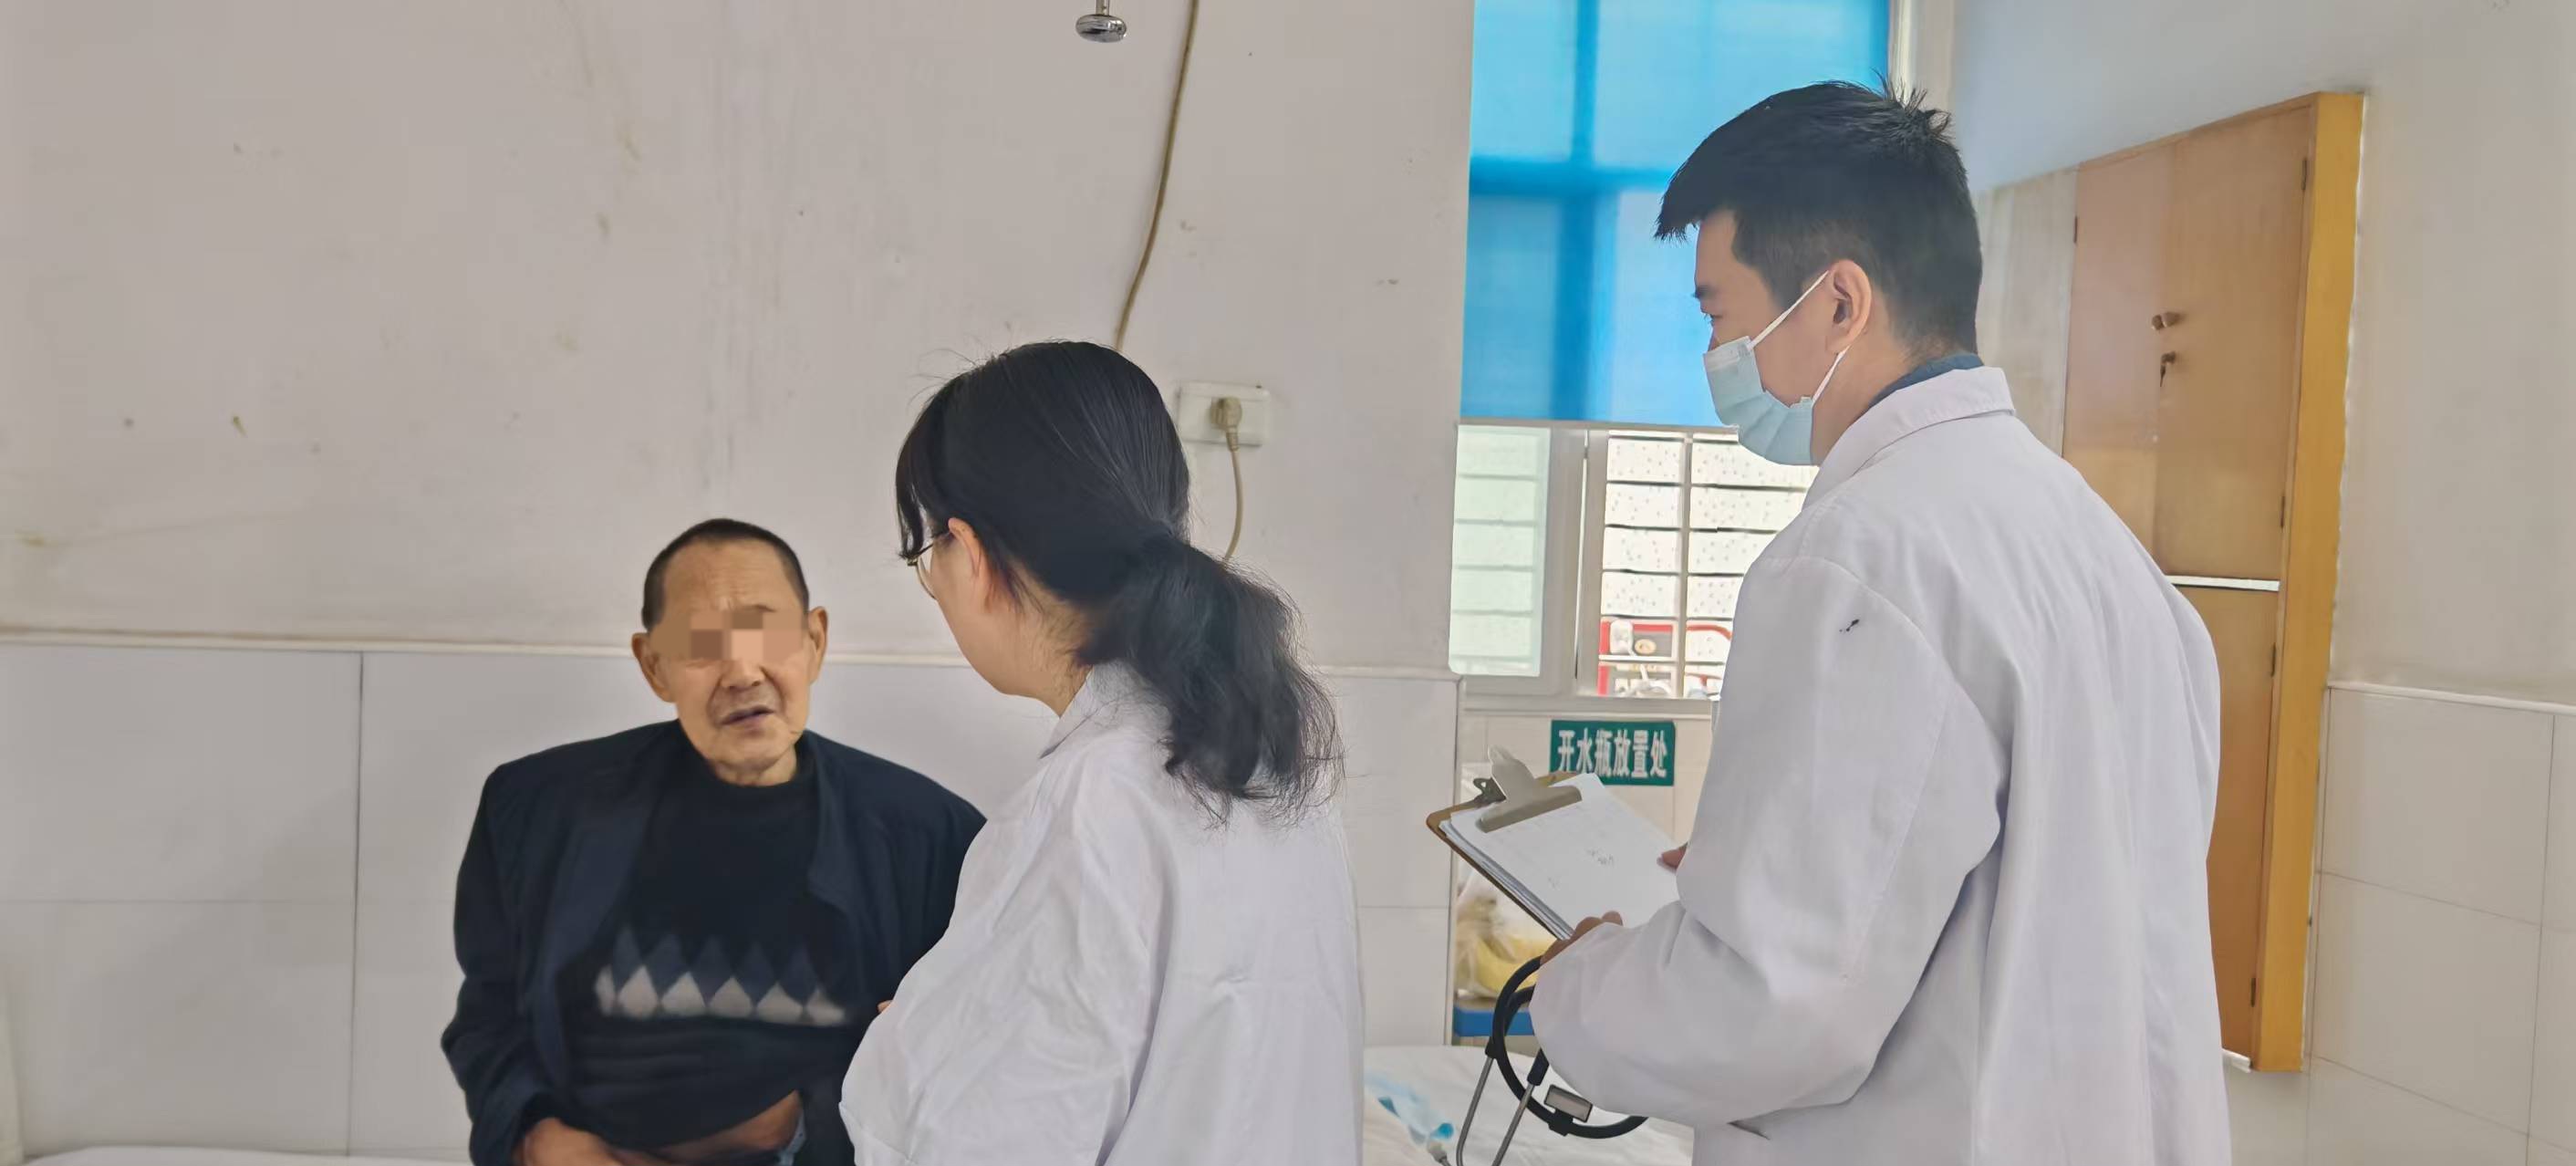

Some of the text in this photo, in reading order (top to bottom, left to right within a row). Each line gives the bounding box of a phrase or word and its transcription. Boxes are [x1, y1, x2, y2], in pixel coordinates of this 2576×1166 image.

[1557, 727, 1667, 777] 开水瓶放置处
